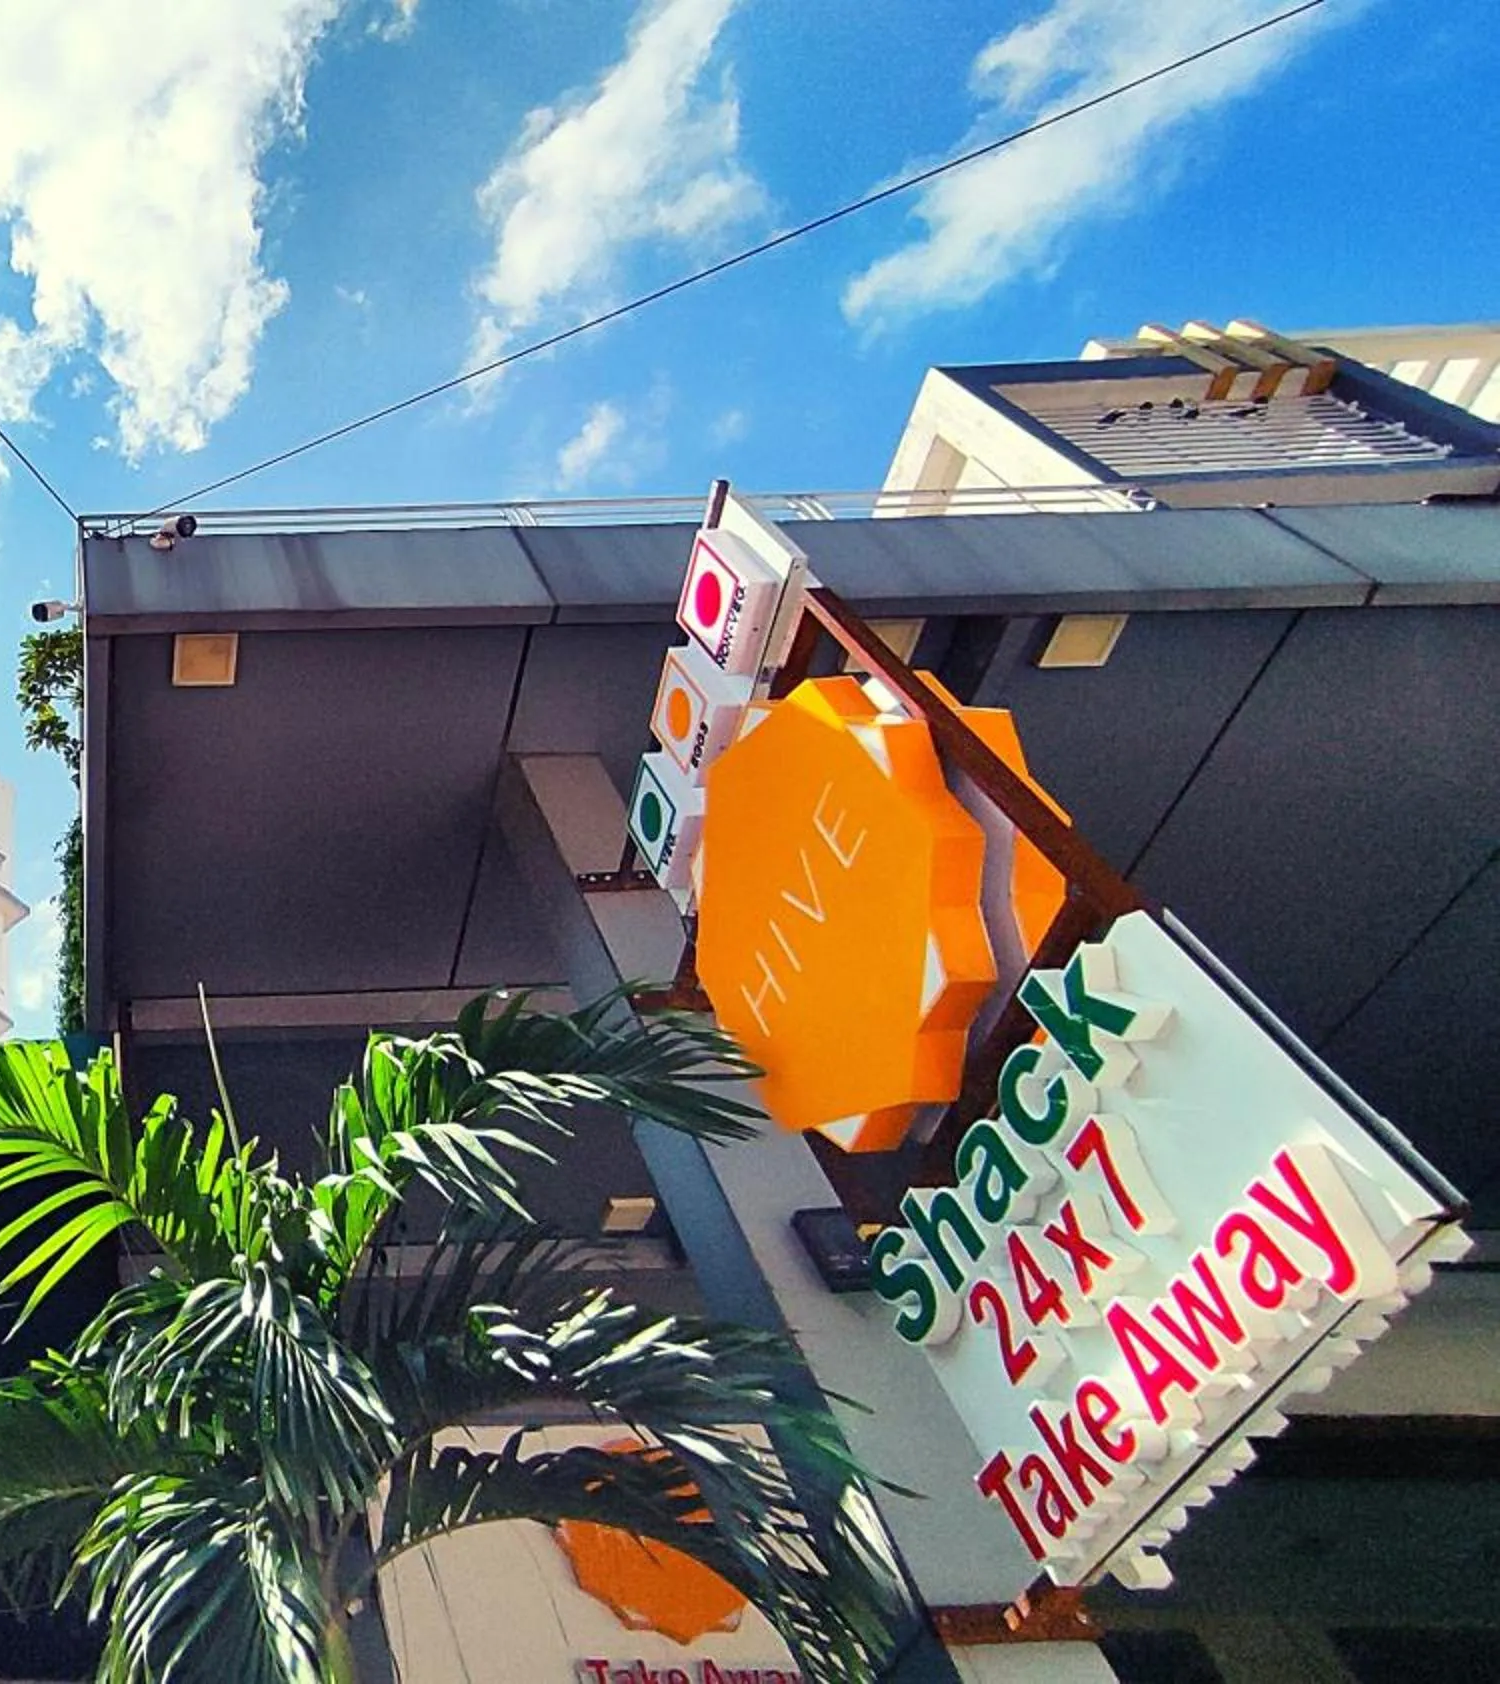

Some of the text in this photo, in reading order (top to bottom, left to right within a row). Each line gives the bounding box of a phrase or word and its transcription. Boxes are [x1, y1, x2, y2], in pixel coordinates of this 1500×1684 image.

[740, 780, 868, 1037] HIVE
[869, 952, 1139, 1344] Shack
[977, 1148, 1357, 1561] Take Away
